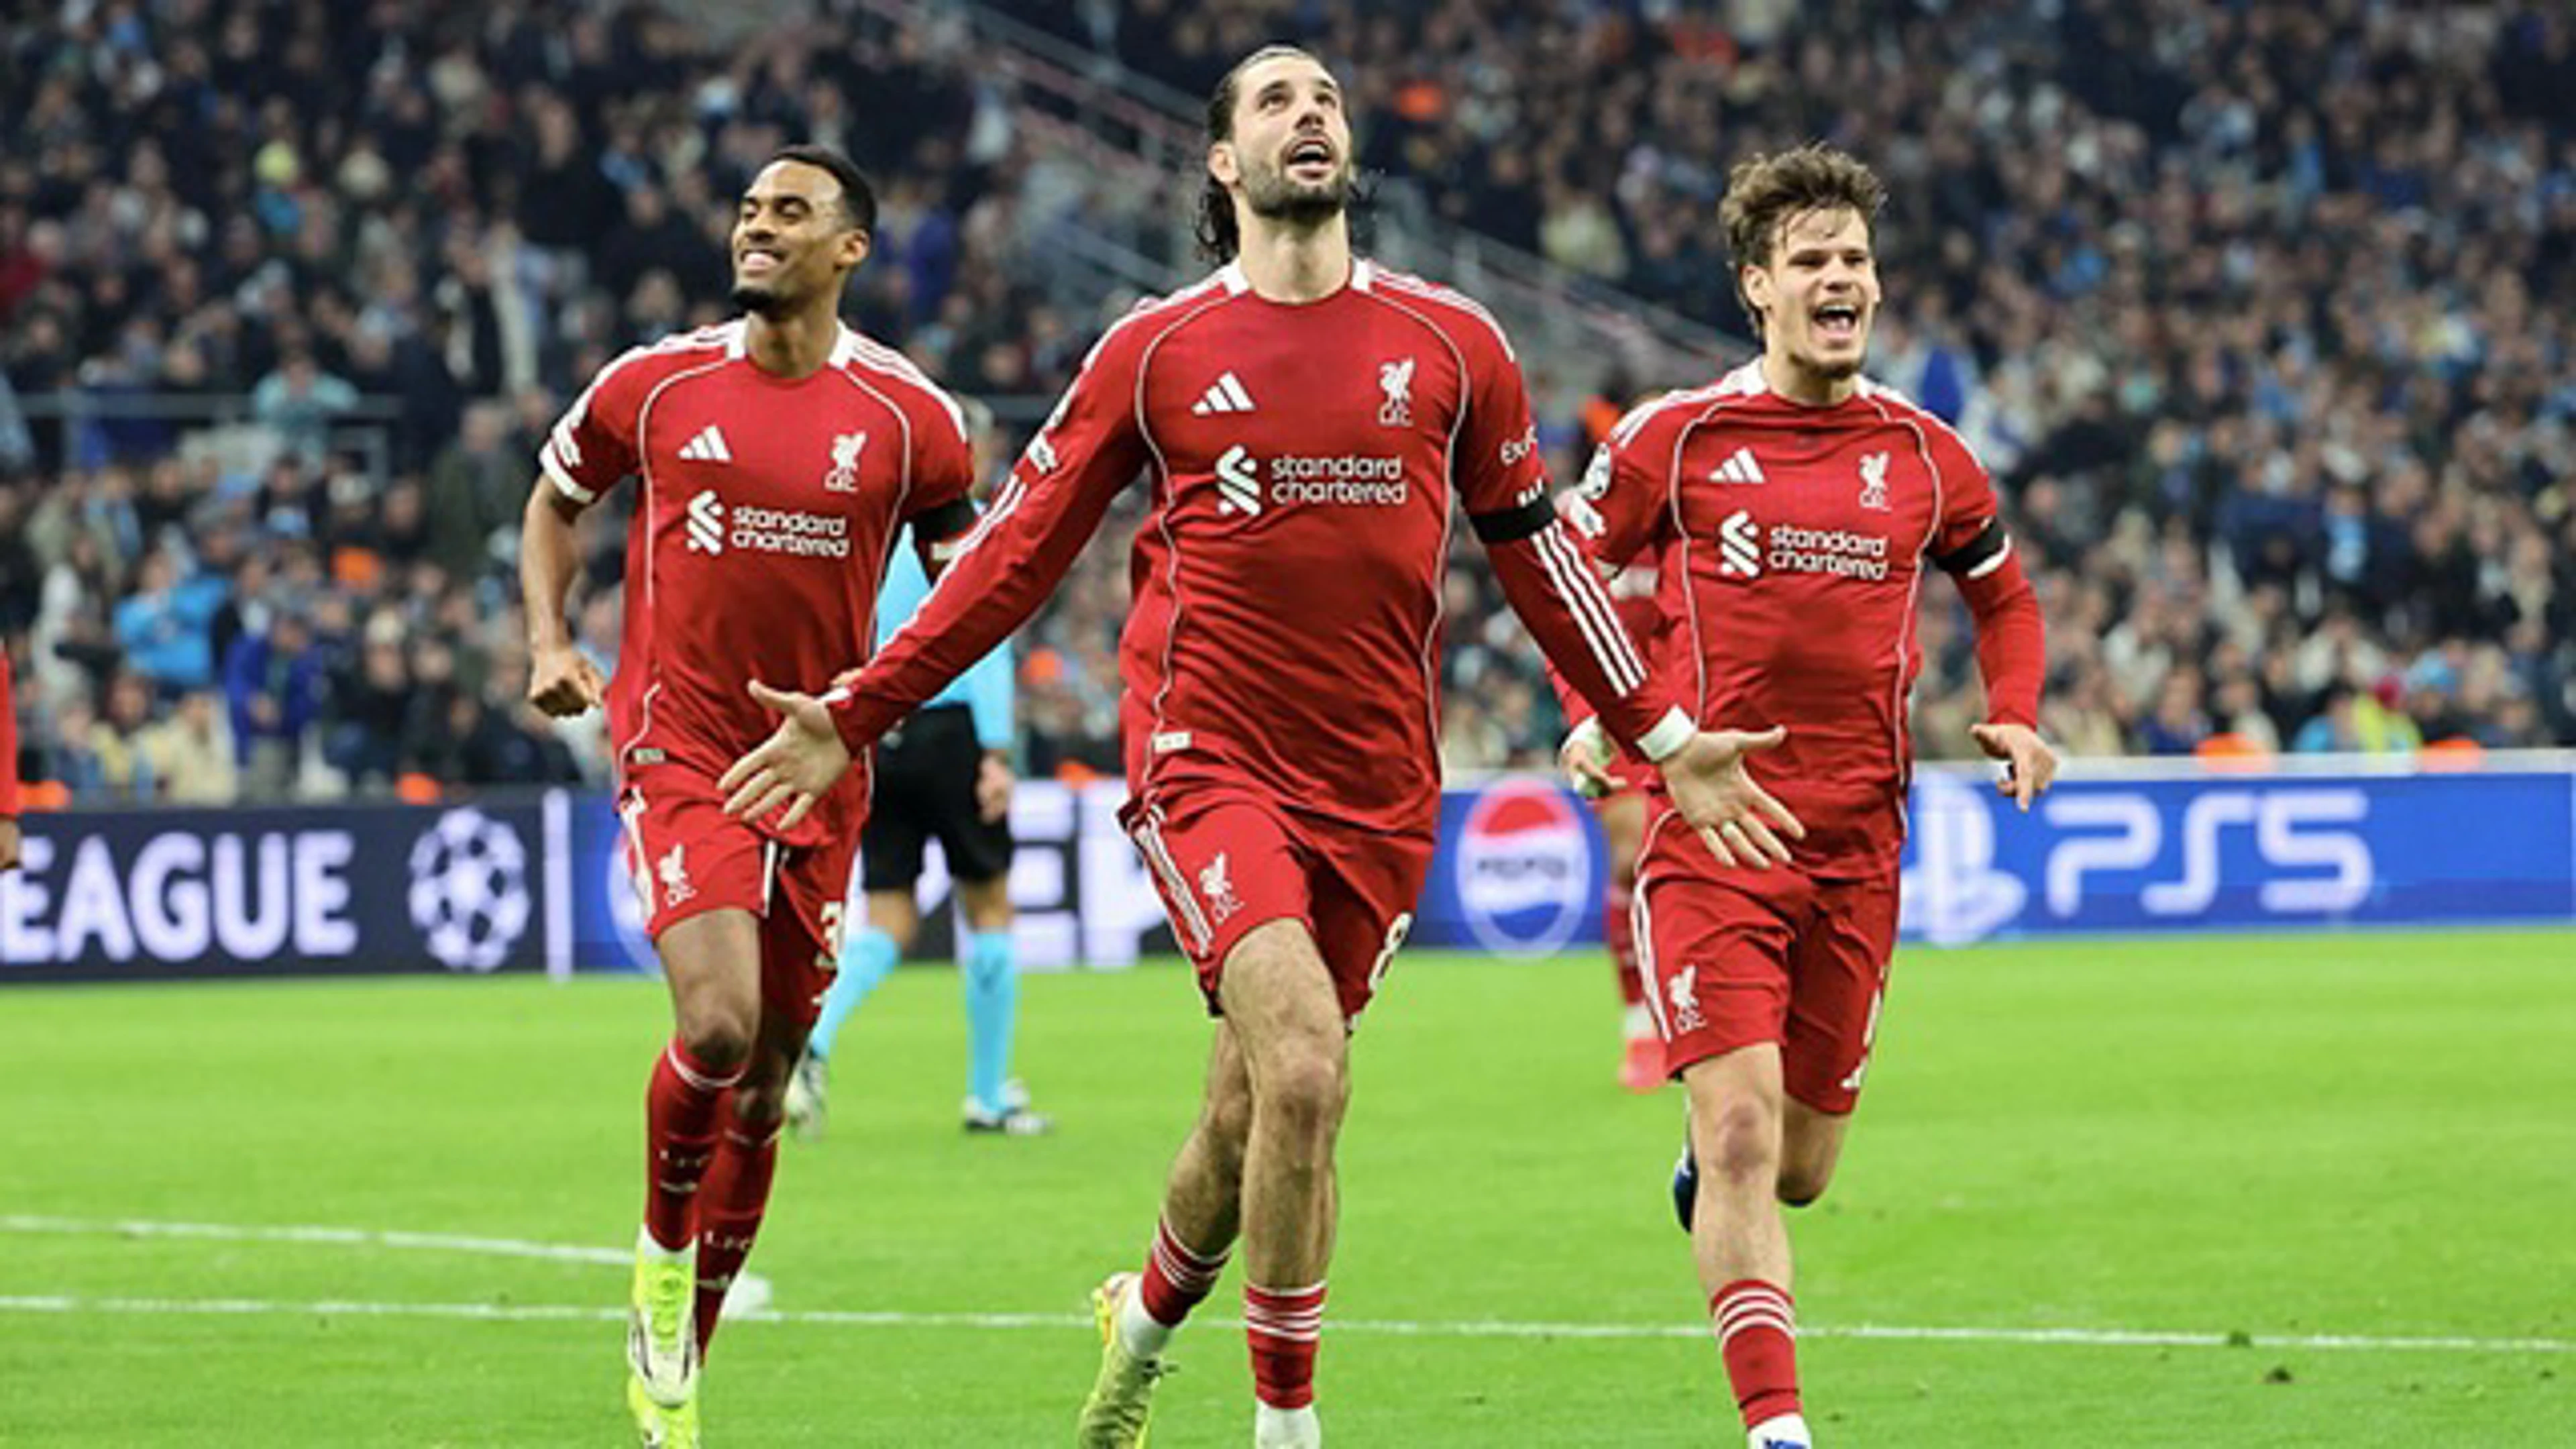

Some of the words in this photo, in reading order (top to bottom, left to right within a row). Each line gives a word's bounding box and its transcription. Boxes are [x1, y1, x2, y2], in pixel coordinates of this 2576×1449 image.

[1271, 453, 1403, 480] standard
[1271, 478, 1407, 506] chartered
[732, 506, 847, 537] standard
[731, 530, 851, 558] chartered
[1770, 523, 1890, 558] standard
[1767, 549, 1890, 581] chartered
[2043, 788, 2376, 918] PS5
